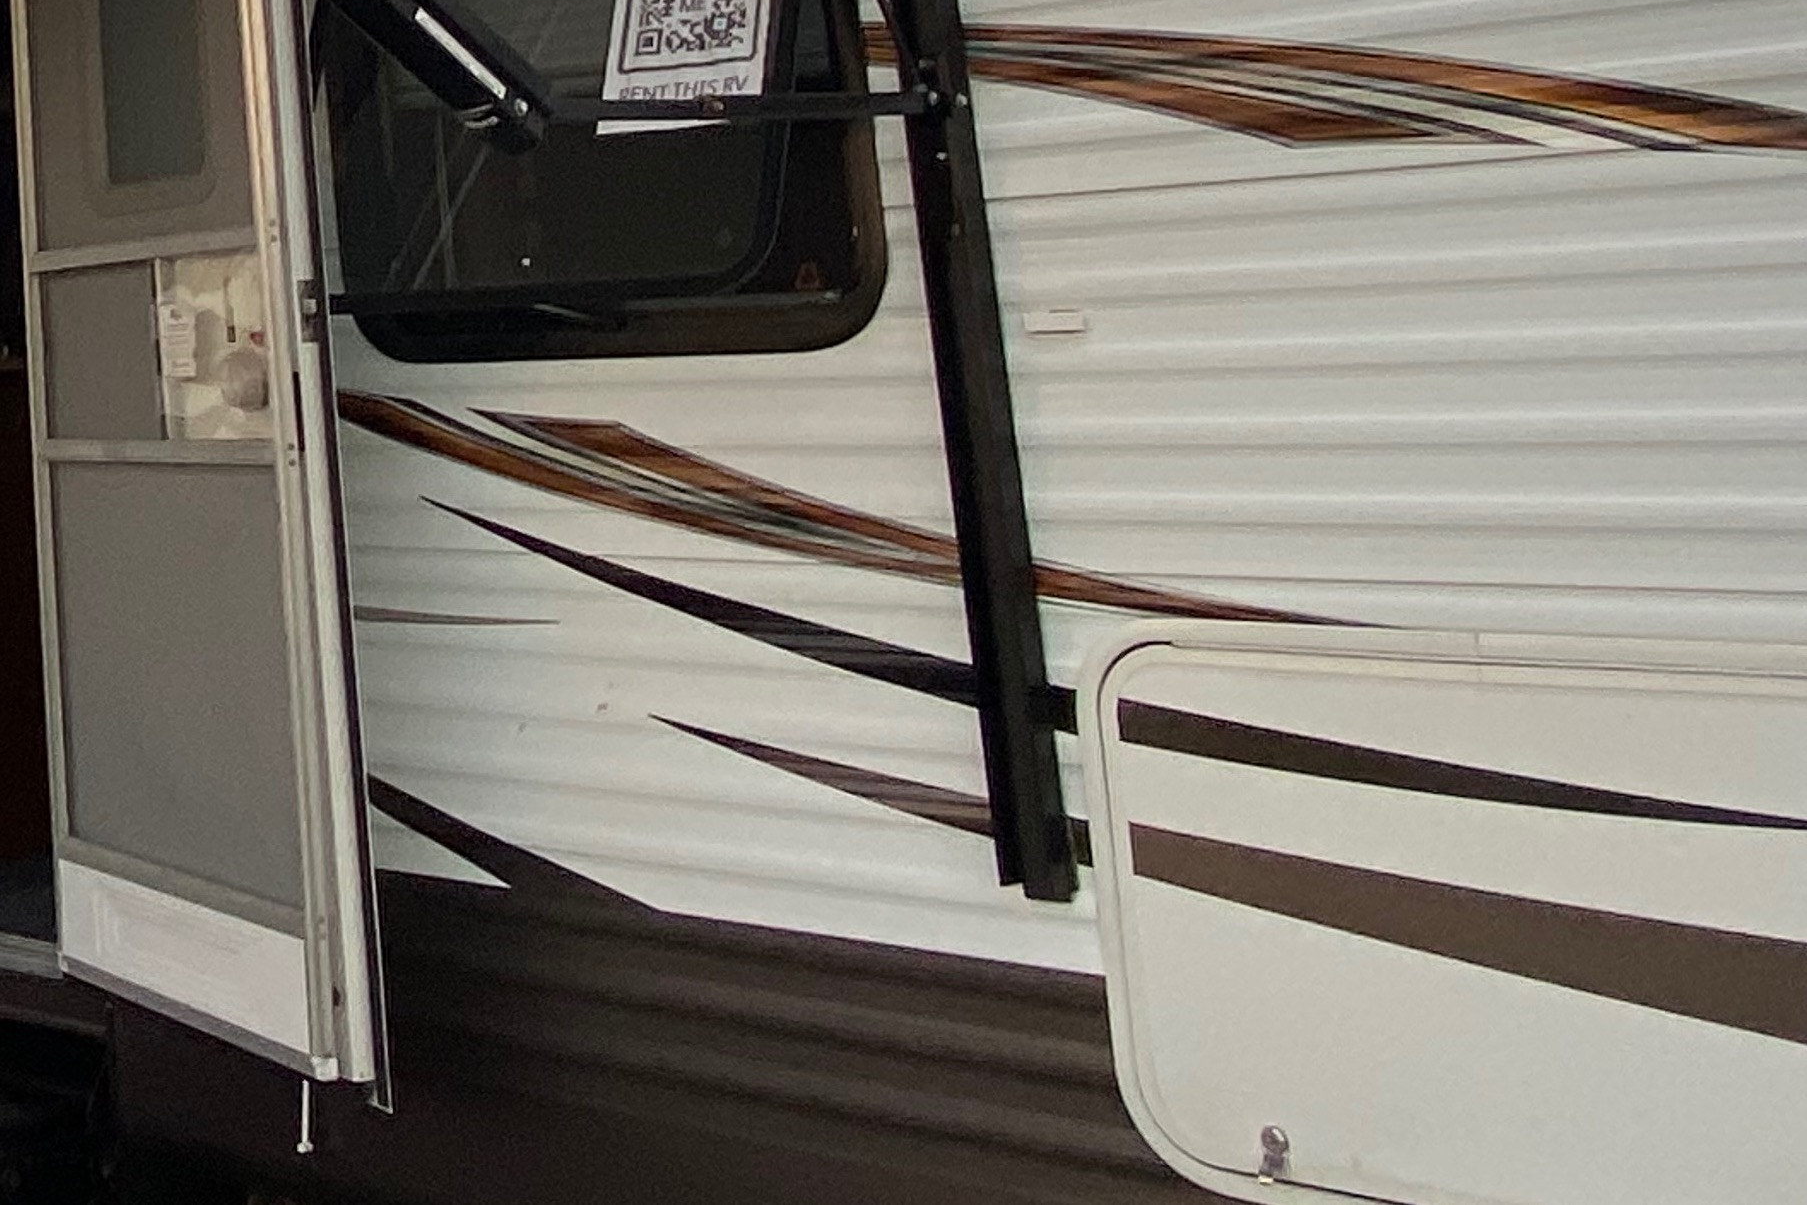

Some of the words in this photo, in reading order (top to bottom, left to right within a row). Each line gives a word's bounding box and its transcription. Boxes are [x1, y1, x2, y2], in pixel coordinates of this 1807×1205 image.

[619, 84, 669, 100] RENT
[673, 79, 720, 98] THIS
[723, 74, 749, 94] RV
